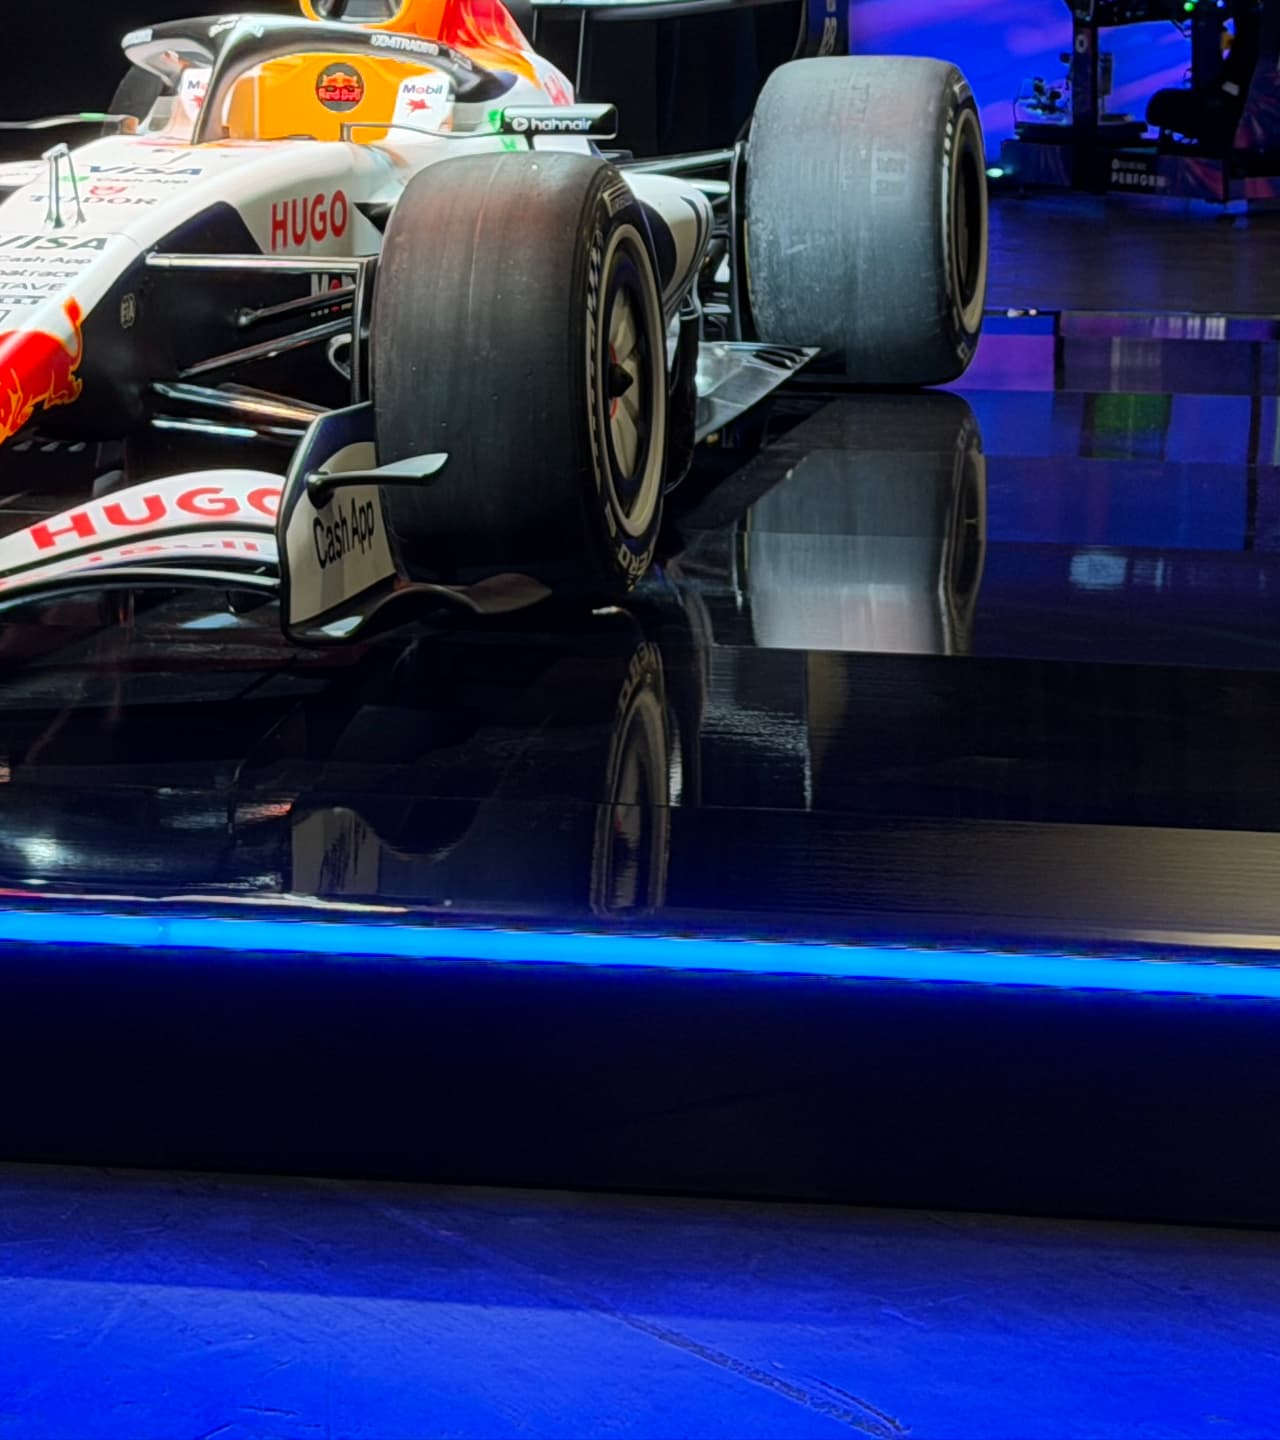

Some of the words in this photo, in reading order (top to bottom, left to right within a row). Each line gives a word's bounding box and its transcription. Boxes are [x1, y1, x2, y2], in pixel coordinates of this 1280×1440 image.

[402, 83, 443, 96] Mobil
[531, 118, 592, 131] hahnair
[89, 165, 203, 175] VISA
[272, 189, 348, 252] HUGO
[49, 254, 92, 265] App
[313, 504, 350, 570] Cash
[351, 497, 375, 555] App
